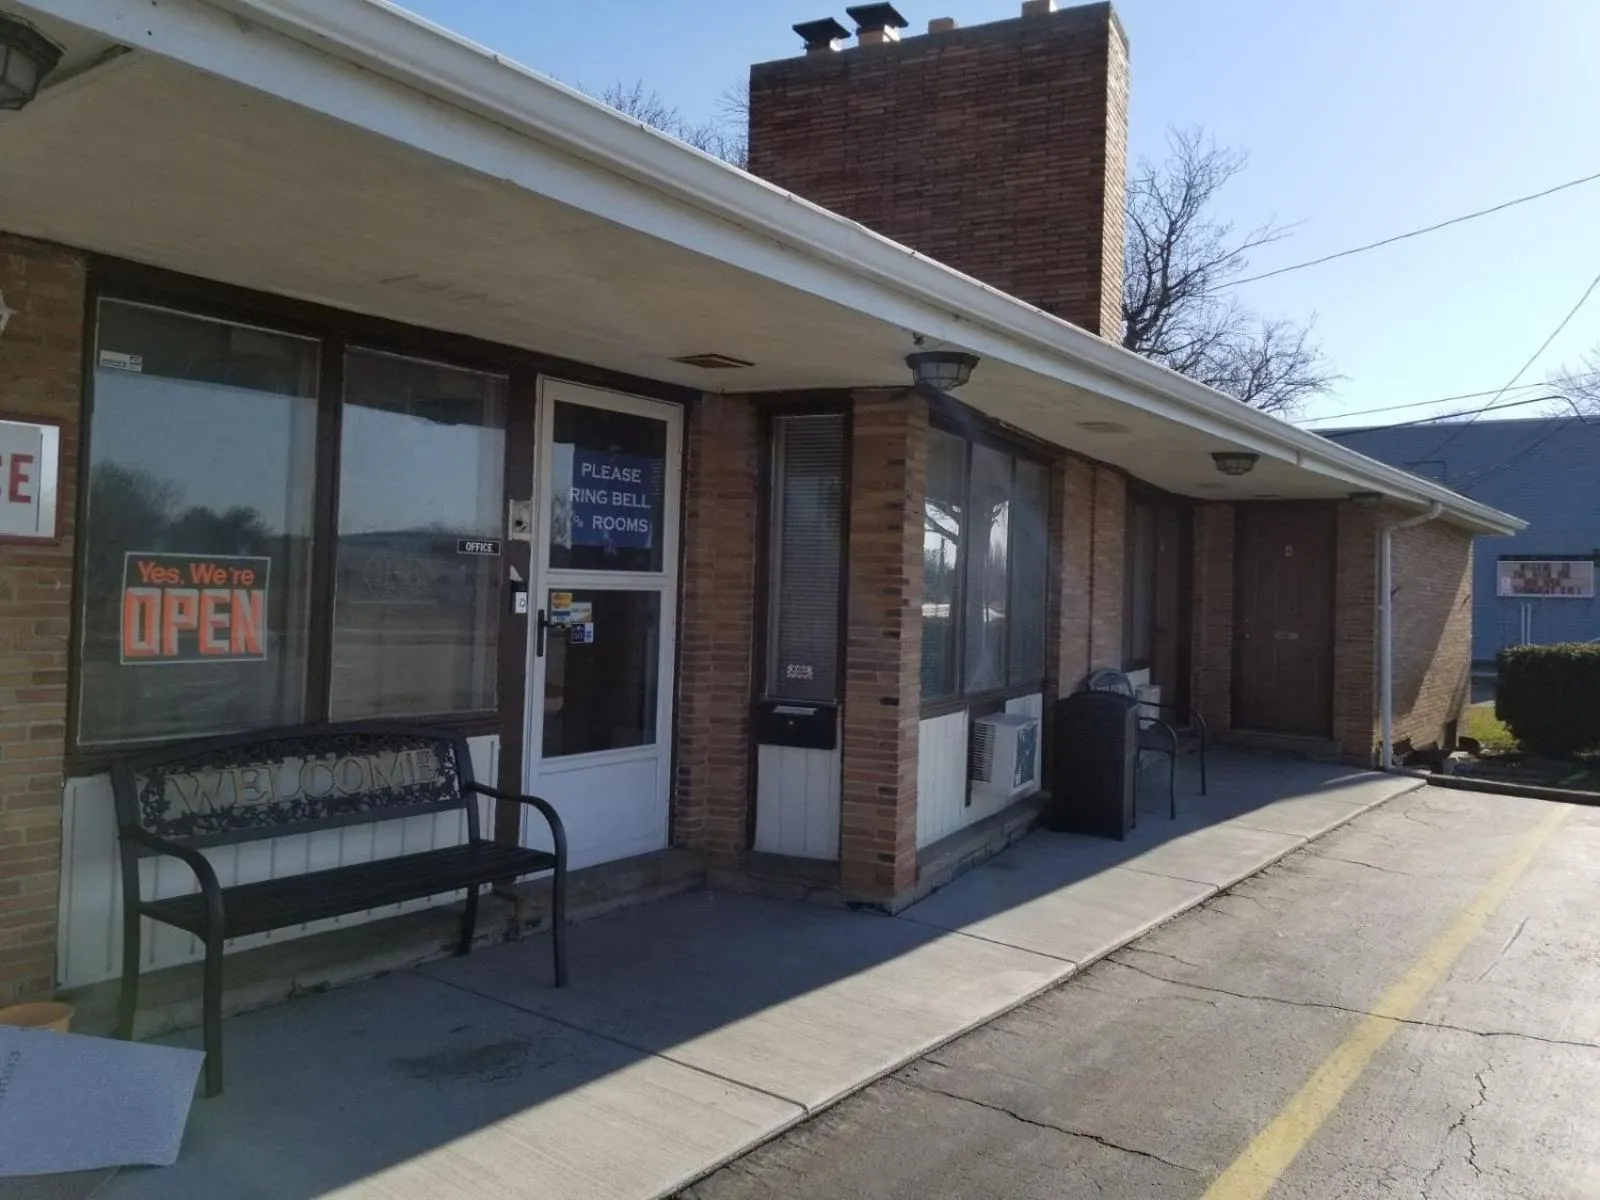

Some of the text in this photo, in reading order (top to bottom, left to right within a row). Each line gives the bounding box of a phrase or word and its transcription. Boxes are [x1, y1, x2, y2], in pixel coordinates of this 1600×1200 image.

[0, 453, 33, 504] E
[581, 462, 642, 483] PLEASE
[570, 487, 652, 509] RING BELL
[592, 515, 649, 533] ROOMS
[465, 542, 493, 553] OFFICE
[189, 563, 255, 586] We're
[123, 586, 265, 657] OPEN
[166, 747, 440, 815] WELCOME
